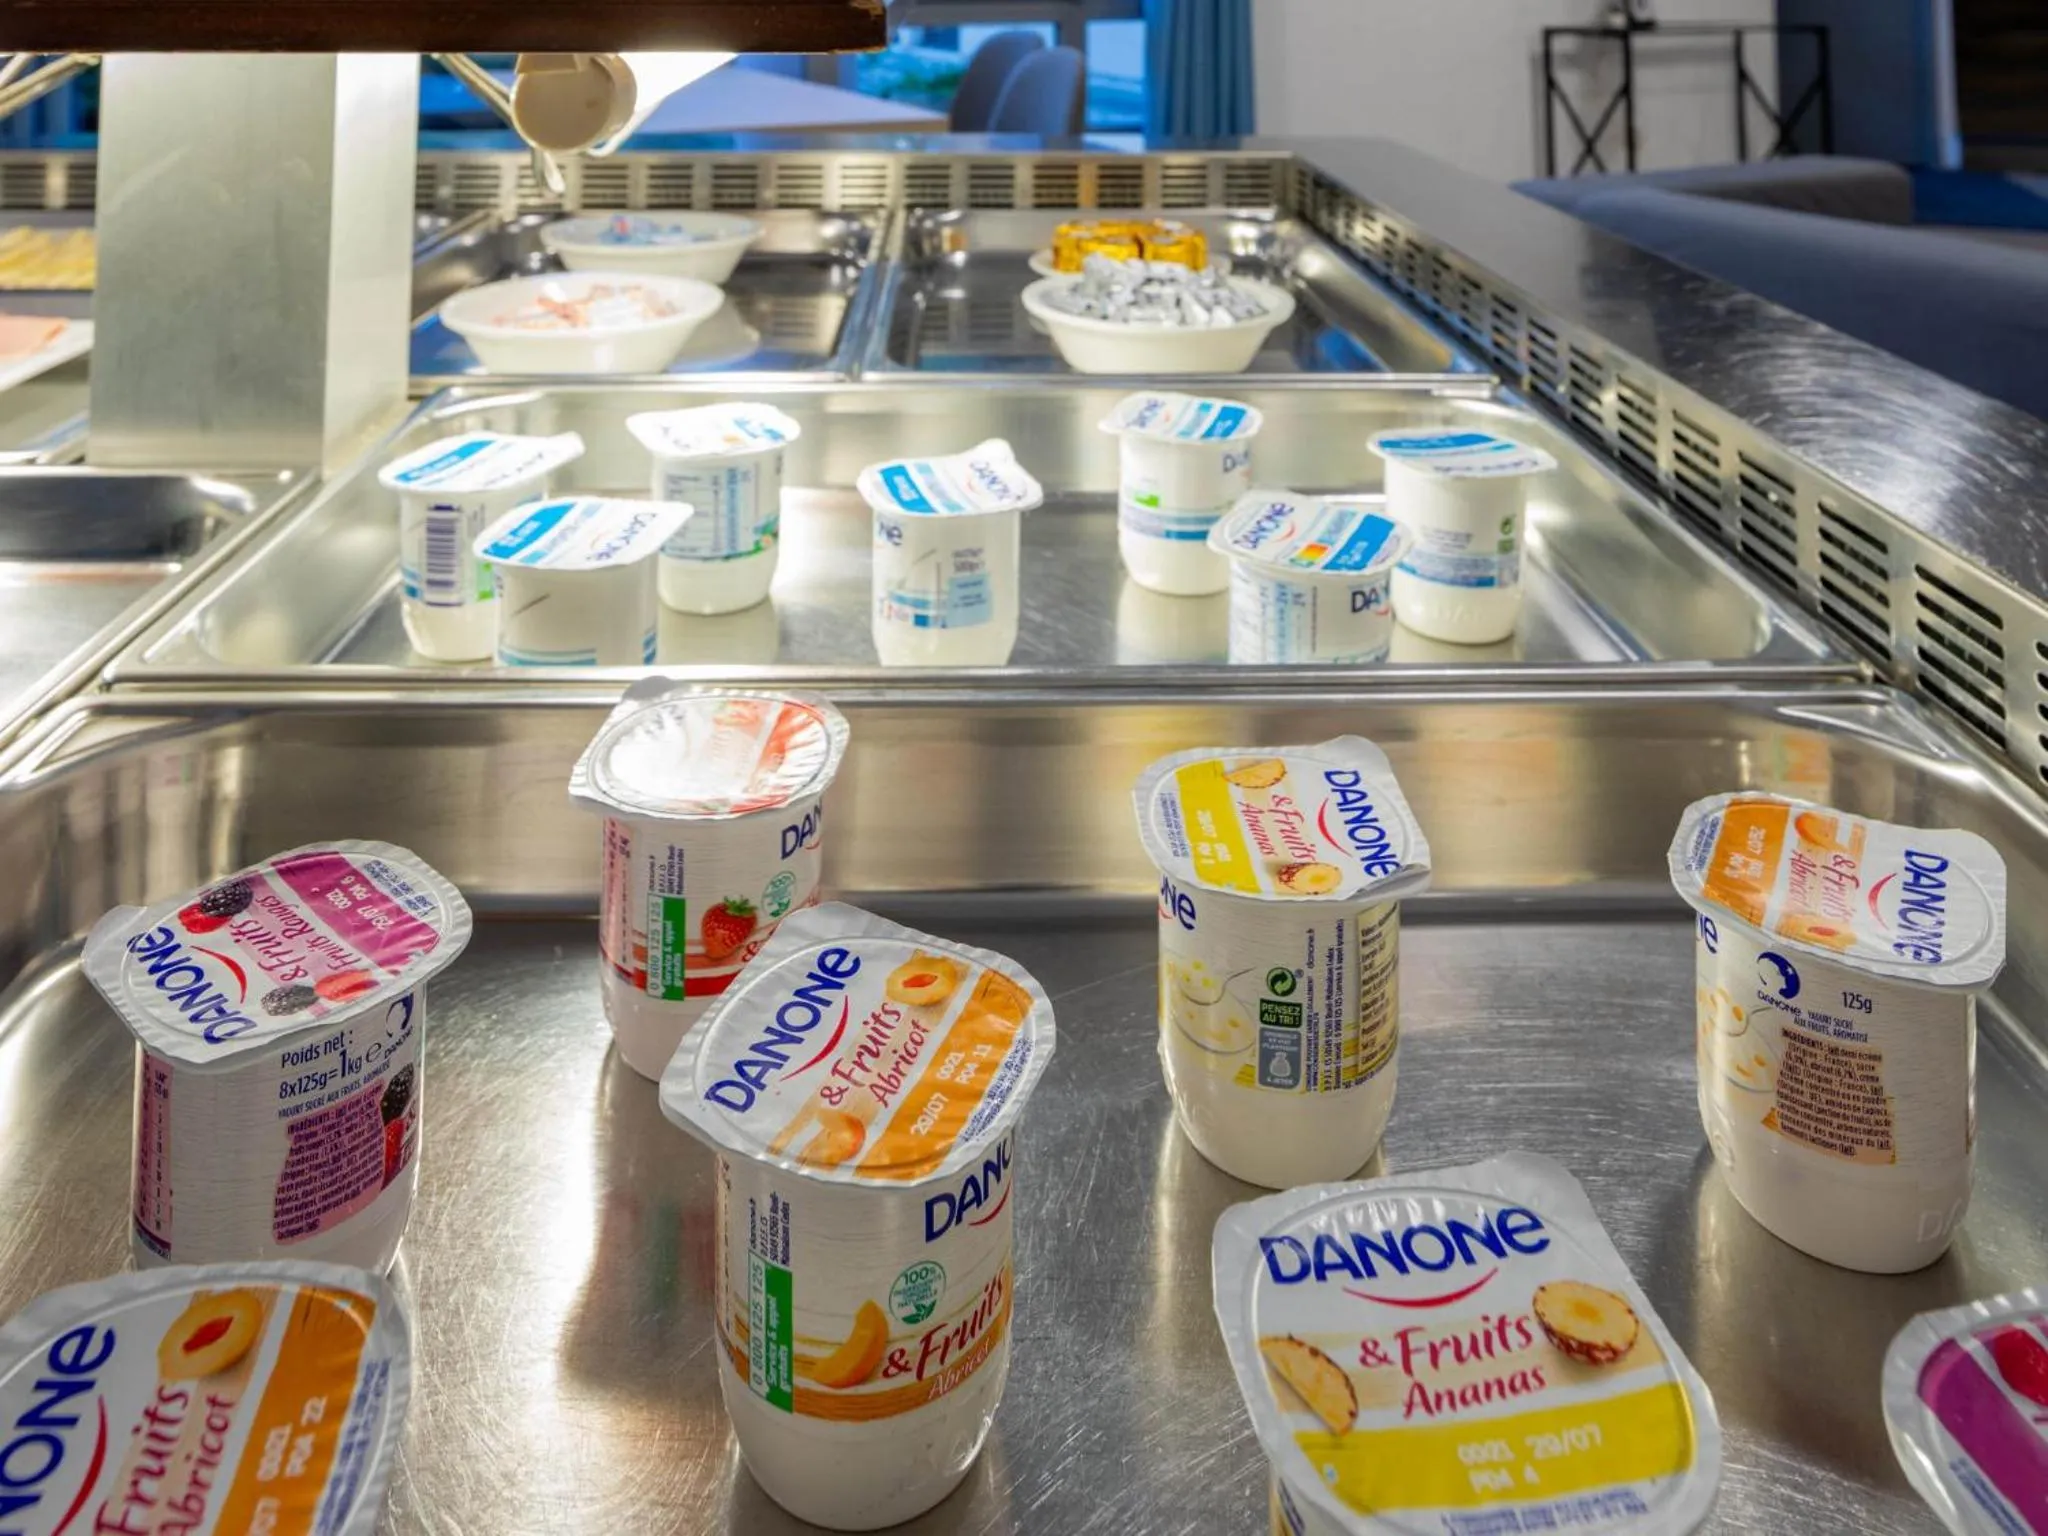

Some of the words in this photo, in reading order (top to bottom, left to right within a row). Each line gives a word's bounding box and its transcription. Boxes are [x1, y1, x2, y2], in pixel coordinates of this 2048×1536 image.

[1267, 808, 1317, 862] Fruits
[1324, 769, 1401, 878] DANONE
[256, 895, 315, 940] Rouges
[1893, 850, 1949, 964] DANONE
[229, 919, 305, 972] Fruits
[280, 961, 308, 982] &
[305, 934, 362, 971] Fruits
[127, 926, 257, 1045] DANONE
[1262, 1003, 1300, 1015] PENSEZ
[1757, 990, 1802, 1016] DANONE
[1842, 991, 1873, 1014] 125g
[704, 947, 861, 1113] DANONE
[831, 1001, 902, 1087] Fruits
[1263, 1014, 1276, 1024] AU
[281, 1042, 321, 1068] Poids
[324, 1031, 345, 1055] net
[868, 1018, 931, 1108] Abricot
[820, 1081, 850, 1107] &
[1259, 1207, 1551, 1285] DANONE
[752, 1262, 763, 1294] 125
[752, 1301, 763, 1331] 125
[881, 1348, 912, 1380] &
[915, 1266, 1006, 1382] Fruits
[1359, 1338, 1395, 1369] &
[1394, 1312, 1534, 1376] Fruits
[1402, 1364, 1547, 1419] Ananas
[0, 1325, 117, 1536] NONE
